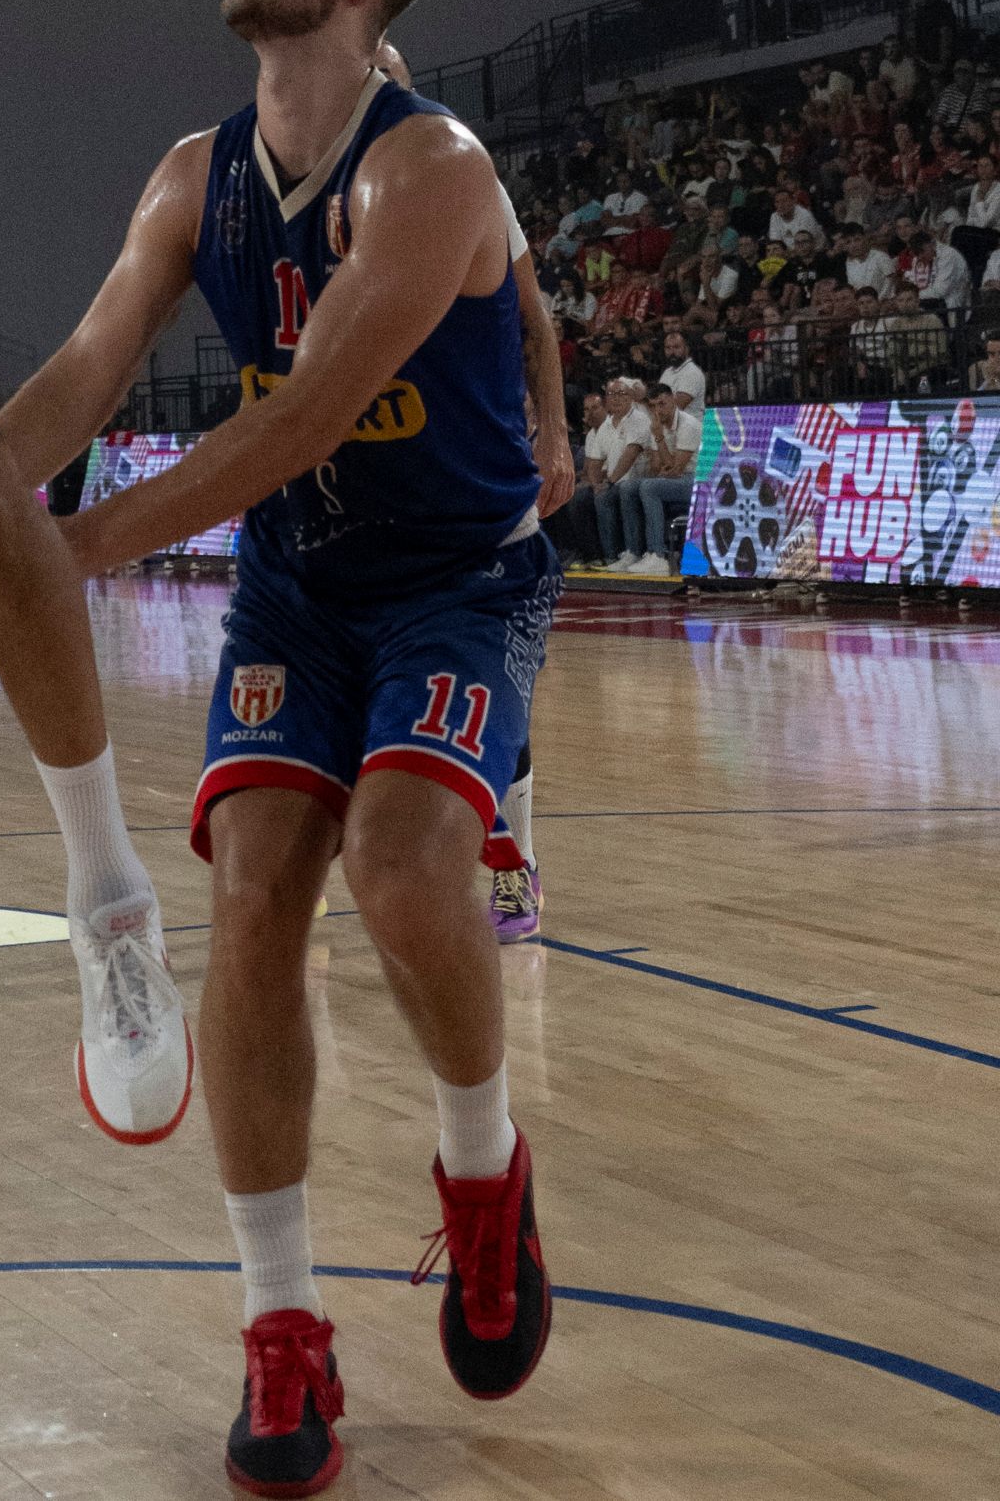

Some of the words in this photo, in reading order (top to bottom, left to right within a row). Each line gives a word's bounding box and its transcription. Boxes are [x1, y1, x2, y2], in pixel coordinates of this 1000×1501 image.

[829, 431, 920, 498] FUN
[819, 499, 911, 559] HUB
[411, 672, 491, 762] 11
